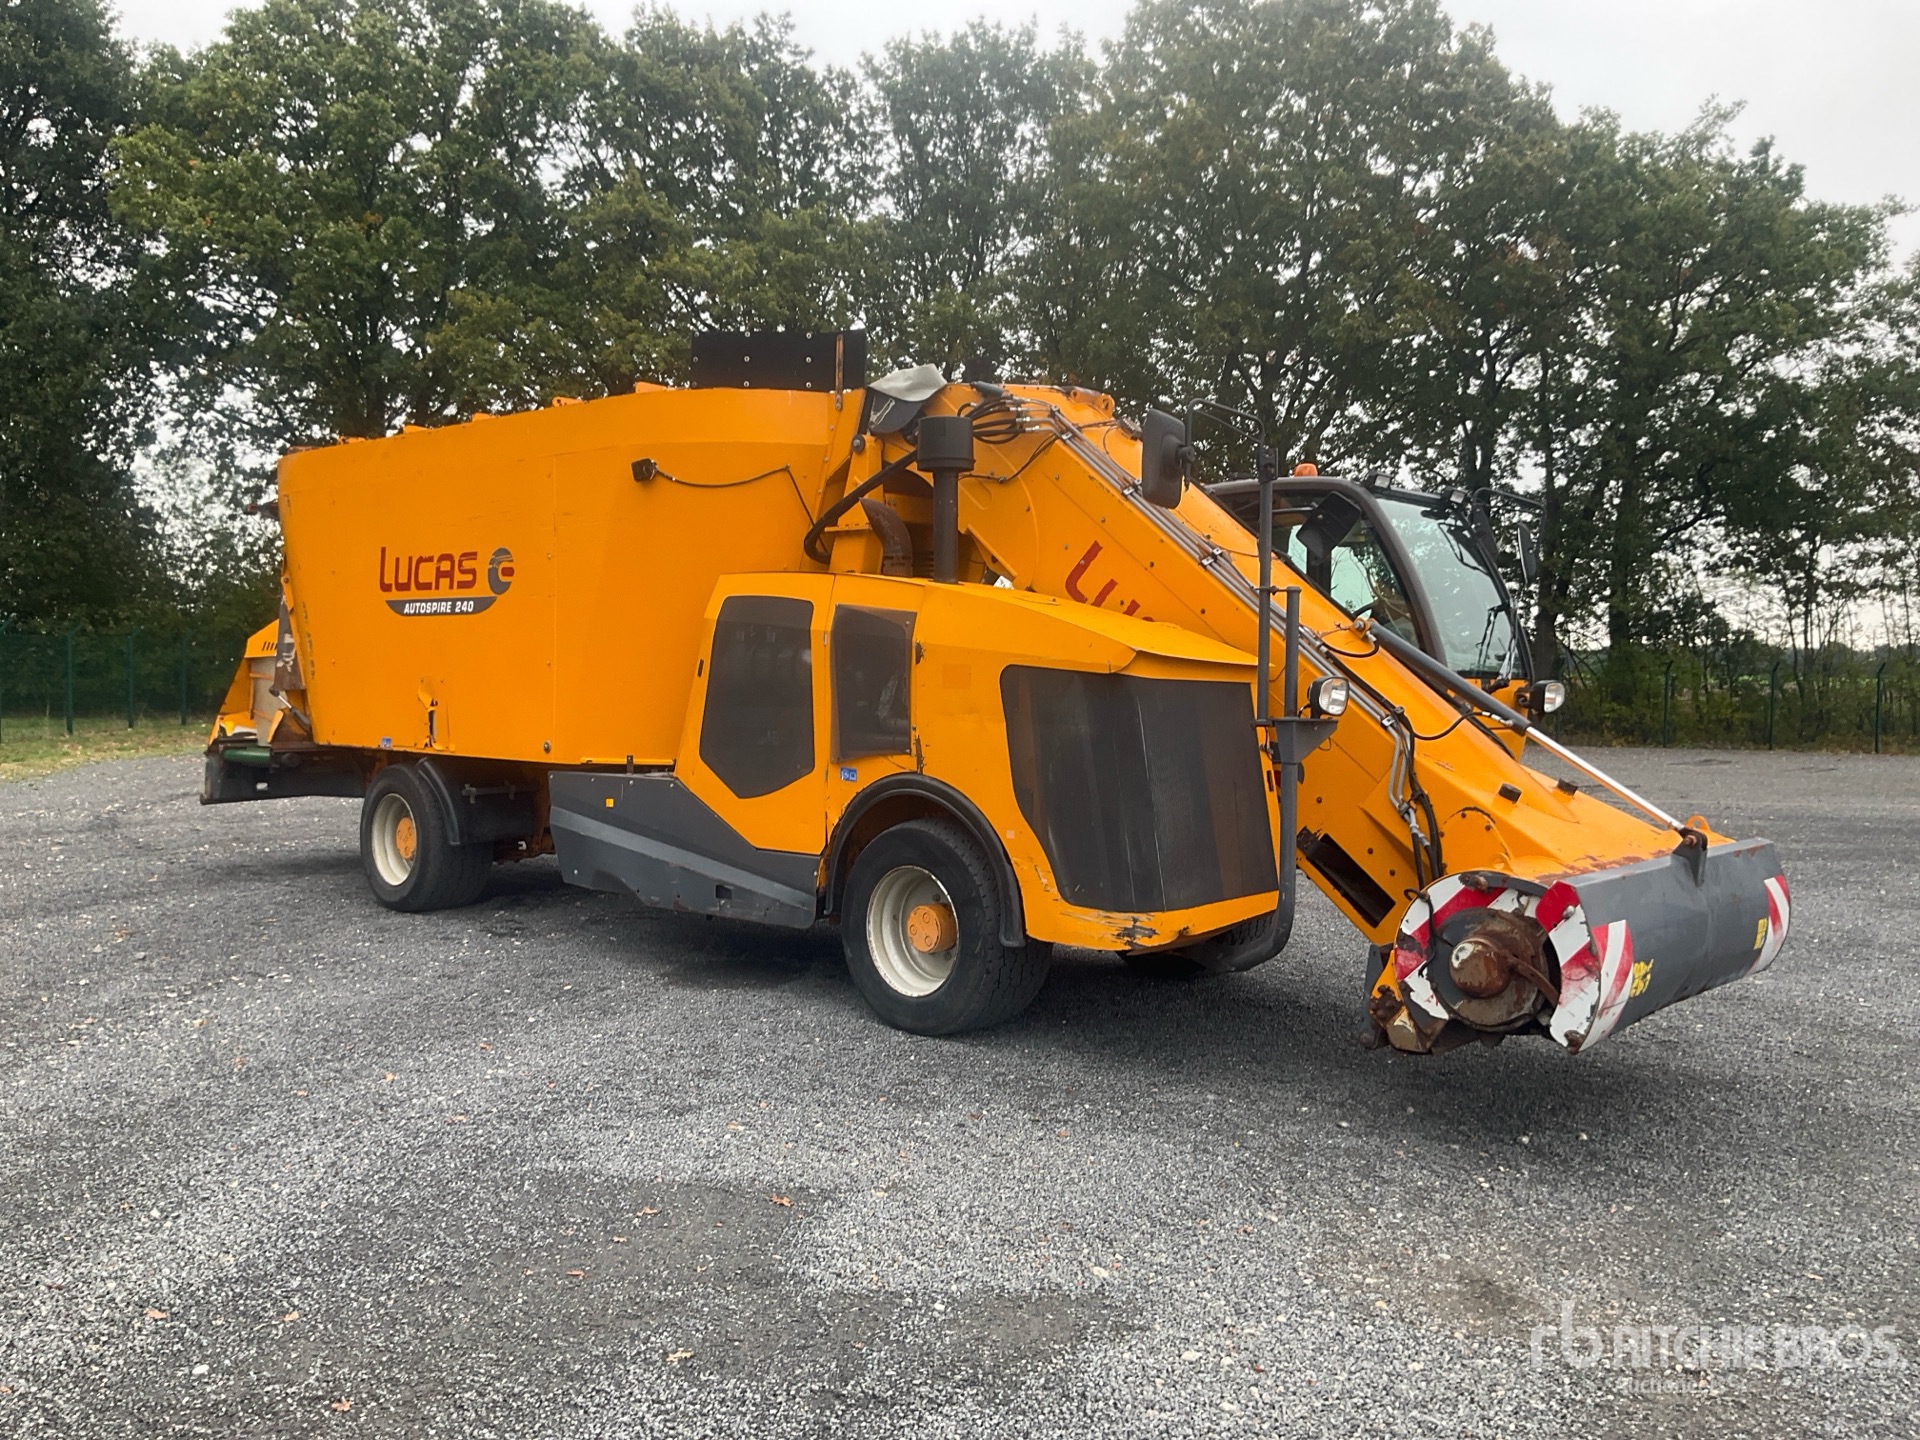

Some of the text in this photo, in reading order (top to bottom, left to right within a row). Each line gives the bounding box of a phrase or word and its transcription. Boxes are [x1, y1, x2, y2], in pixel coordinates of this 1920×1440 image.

[379, 547, 478, 592] LUCAS
[403, 600, 474, 615] AUTOSPIRE 240
